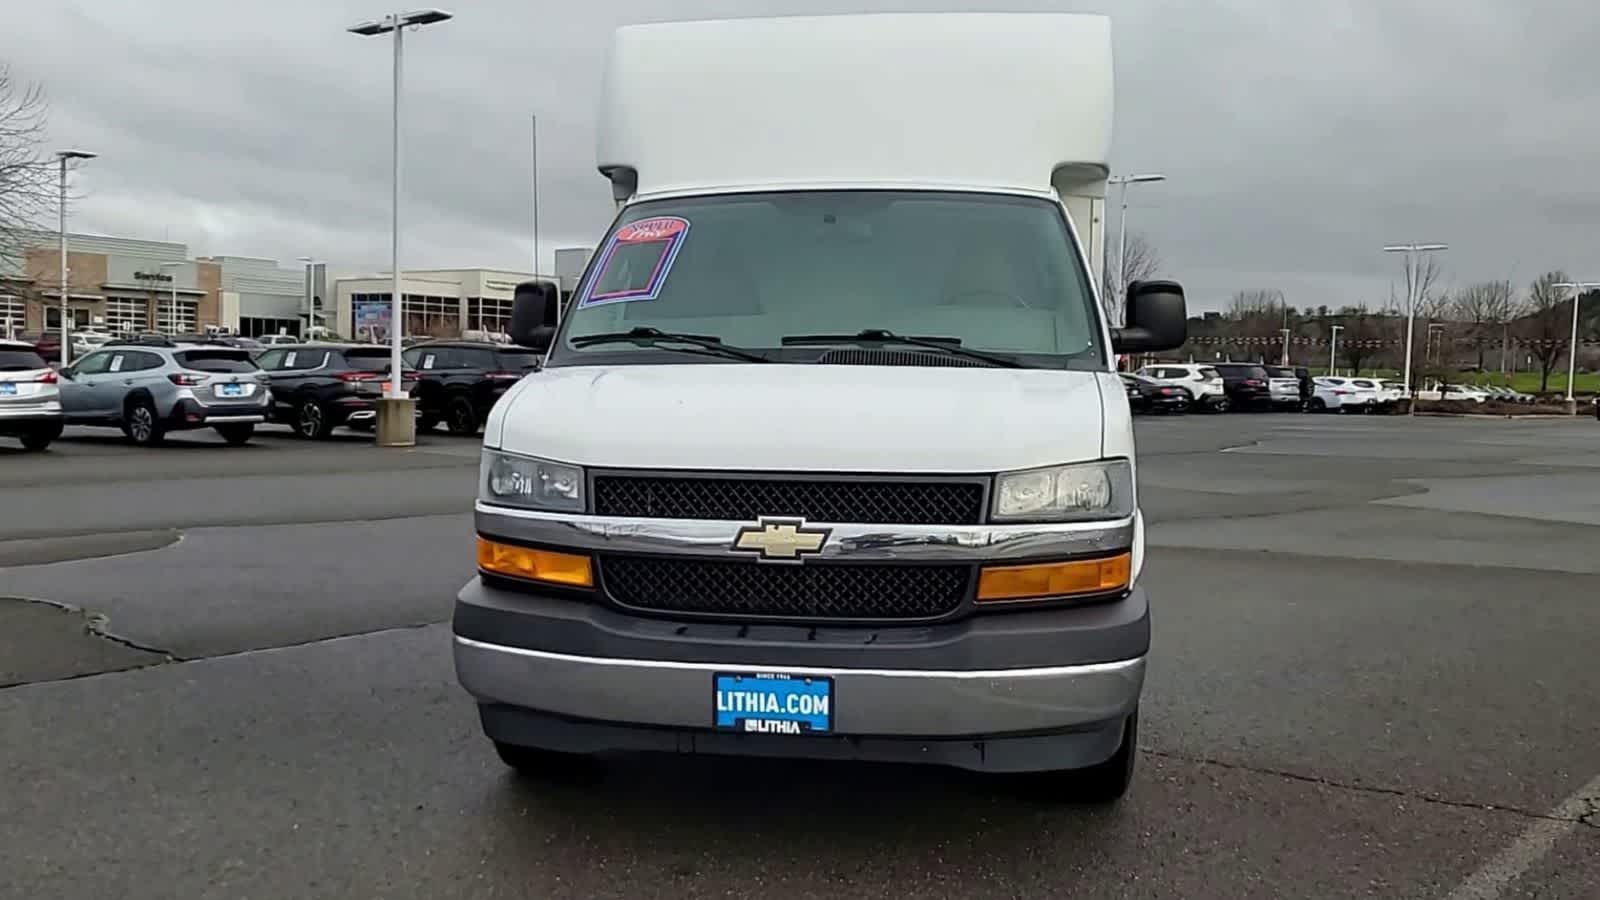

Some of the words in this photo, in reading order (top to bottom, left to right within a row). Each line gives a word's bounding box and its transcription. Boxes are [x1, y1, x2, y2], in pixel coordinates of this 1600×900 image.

[134, 271, 172, 281] Service
[717, 691, 829, 715] LITHIA.COM
[758, 719, 800, 734] LITHIA
